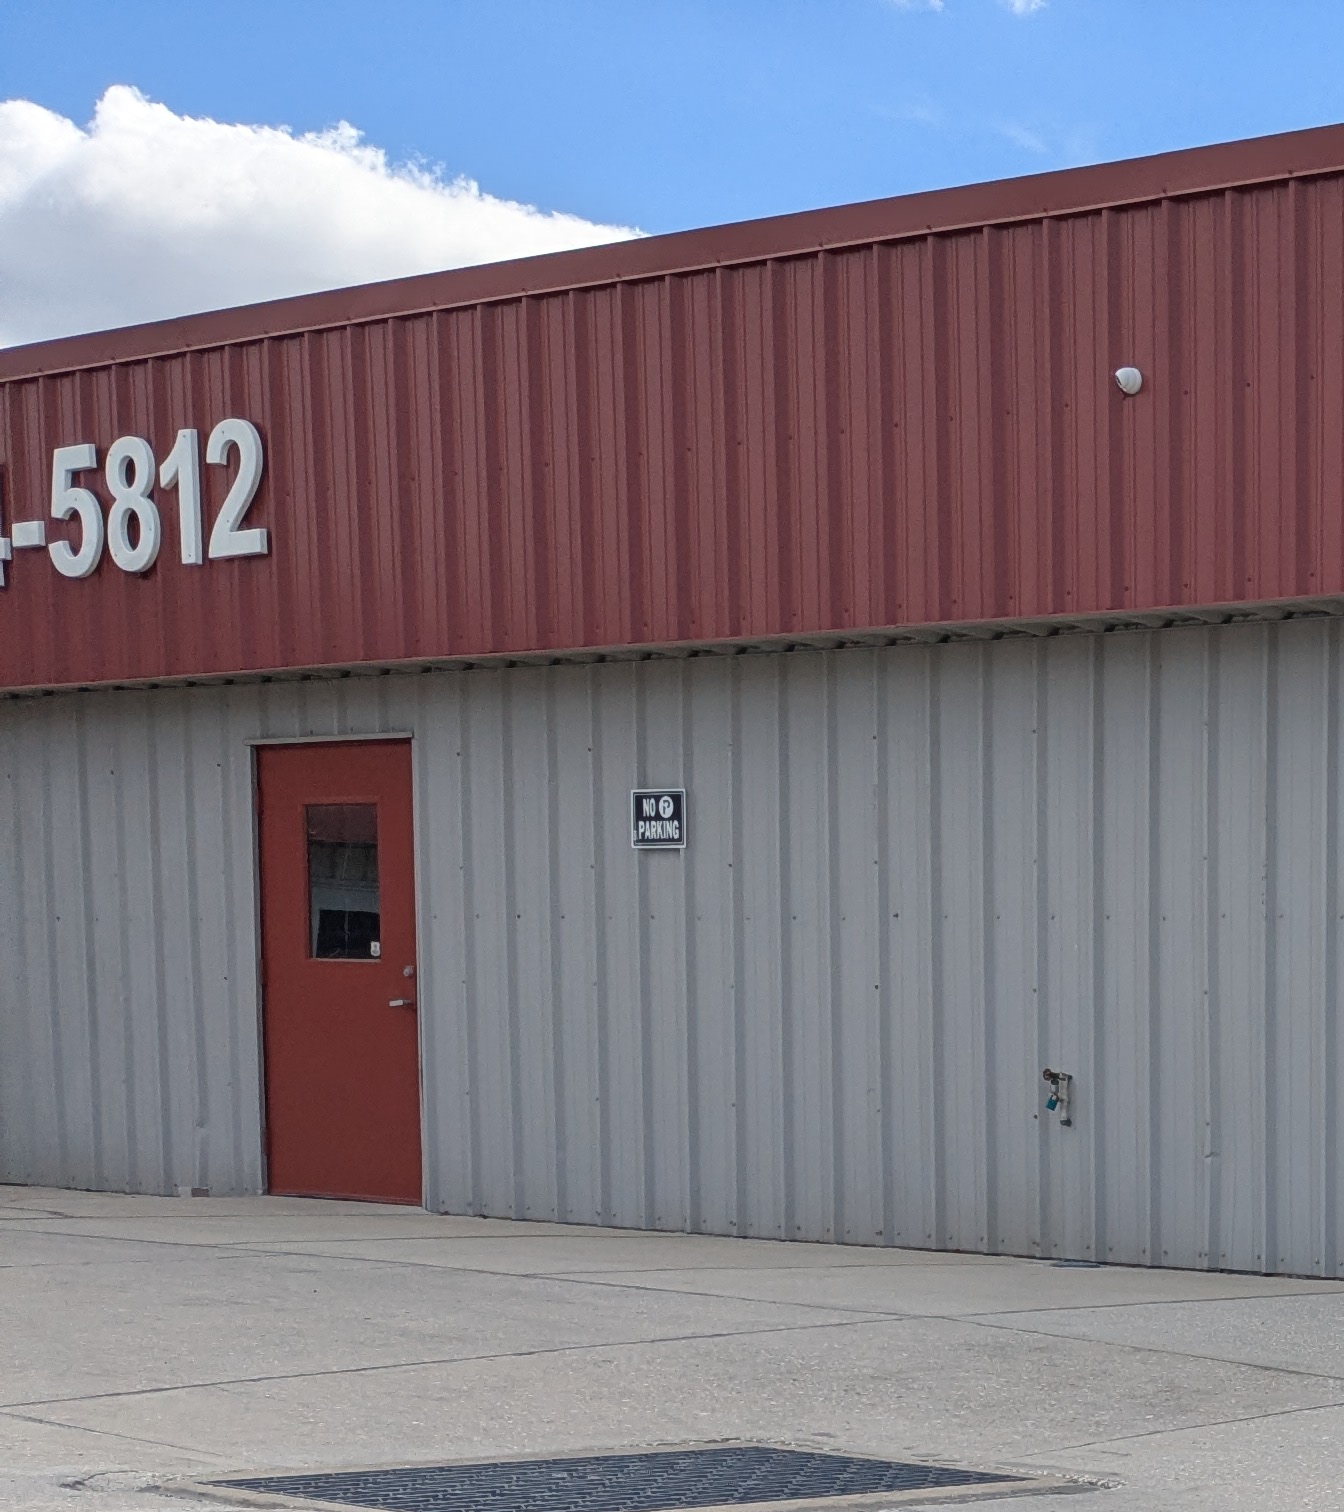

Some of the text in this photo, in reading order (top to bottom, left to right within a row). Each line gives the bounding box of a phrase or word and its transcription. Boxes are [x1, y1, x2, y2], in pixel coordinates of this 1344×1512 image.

[0, 418, 268, 587] -5812
[642, 797, 656, 817] NO
[638, 820, 680, 839] PARKING
